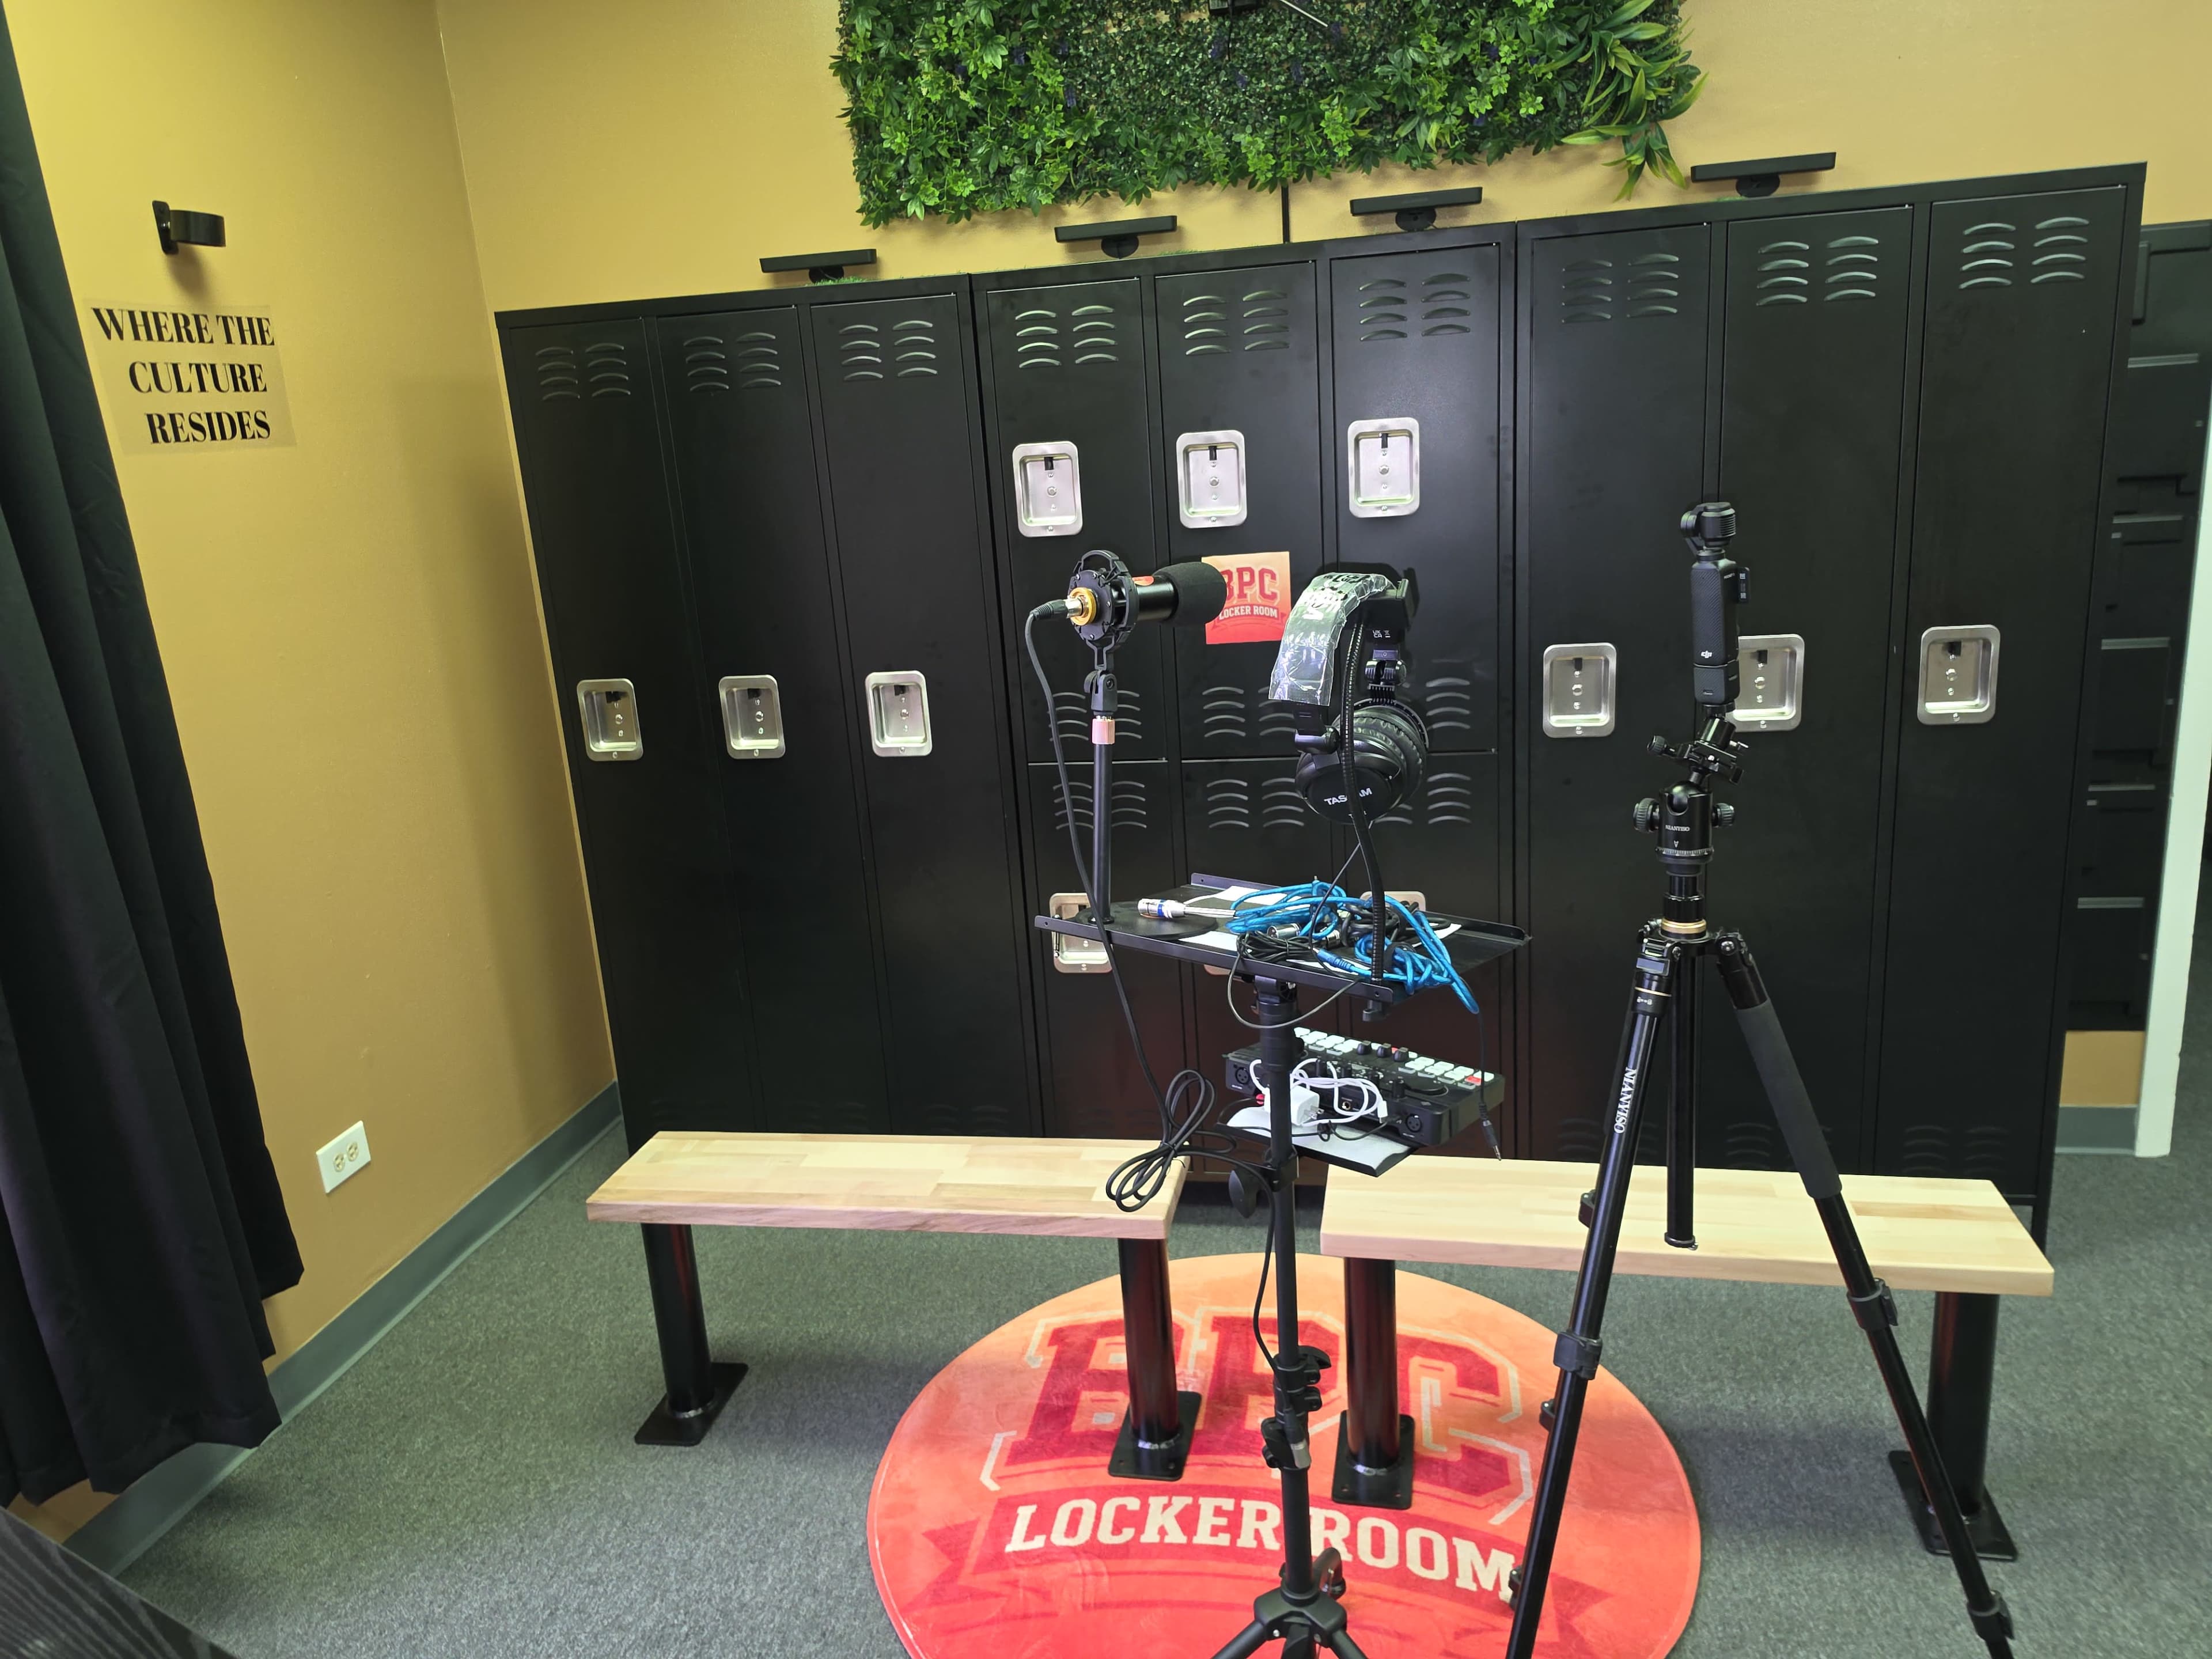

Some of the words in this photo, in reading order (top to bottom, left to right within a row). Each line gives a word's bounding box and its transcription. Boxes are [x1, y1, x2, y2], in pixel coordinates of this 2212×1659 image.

[91, 307, 214, 344] WHERE
[216, 315, 275, 346] THE
[128, 361, 267, 393] CULTURE
[145, 410, 271, 445] RESIDES
[1218, 605, 1251, 620] LOCKER
[1253, 605, 1278, 618] ROOM
[1324, 787, 1373, 805] TASM
[1613, 1066, 1637, 1134] NIANYISO
[1005, 1495, 1281, 1553] LOCKER
[1309, 1506, 1516, 1603] ROOM
